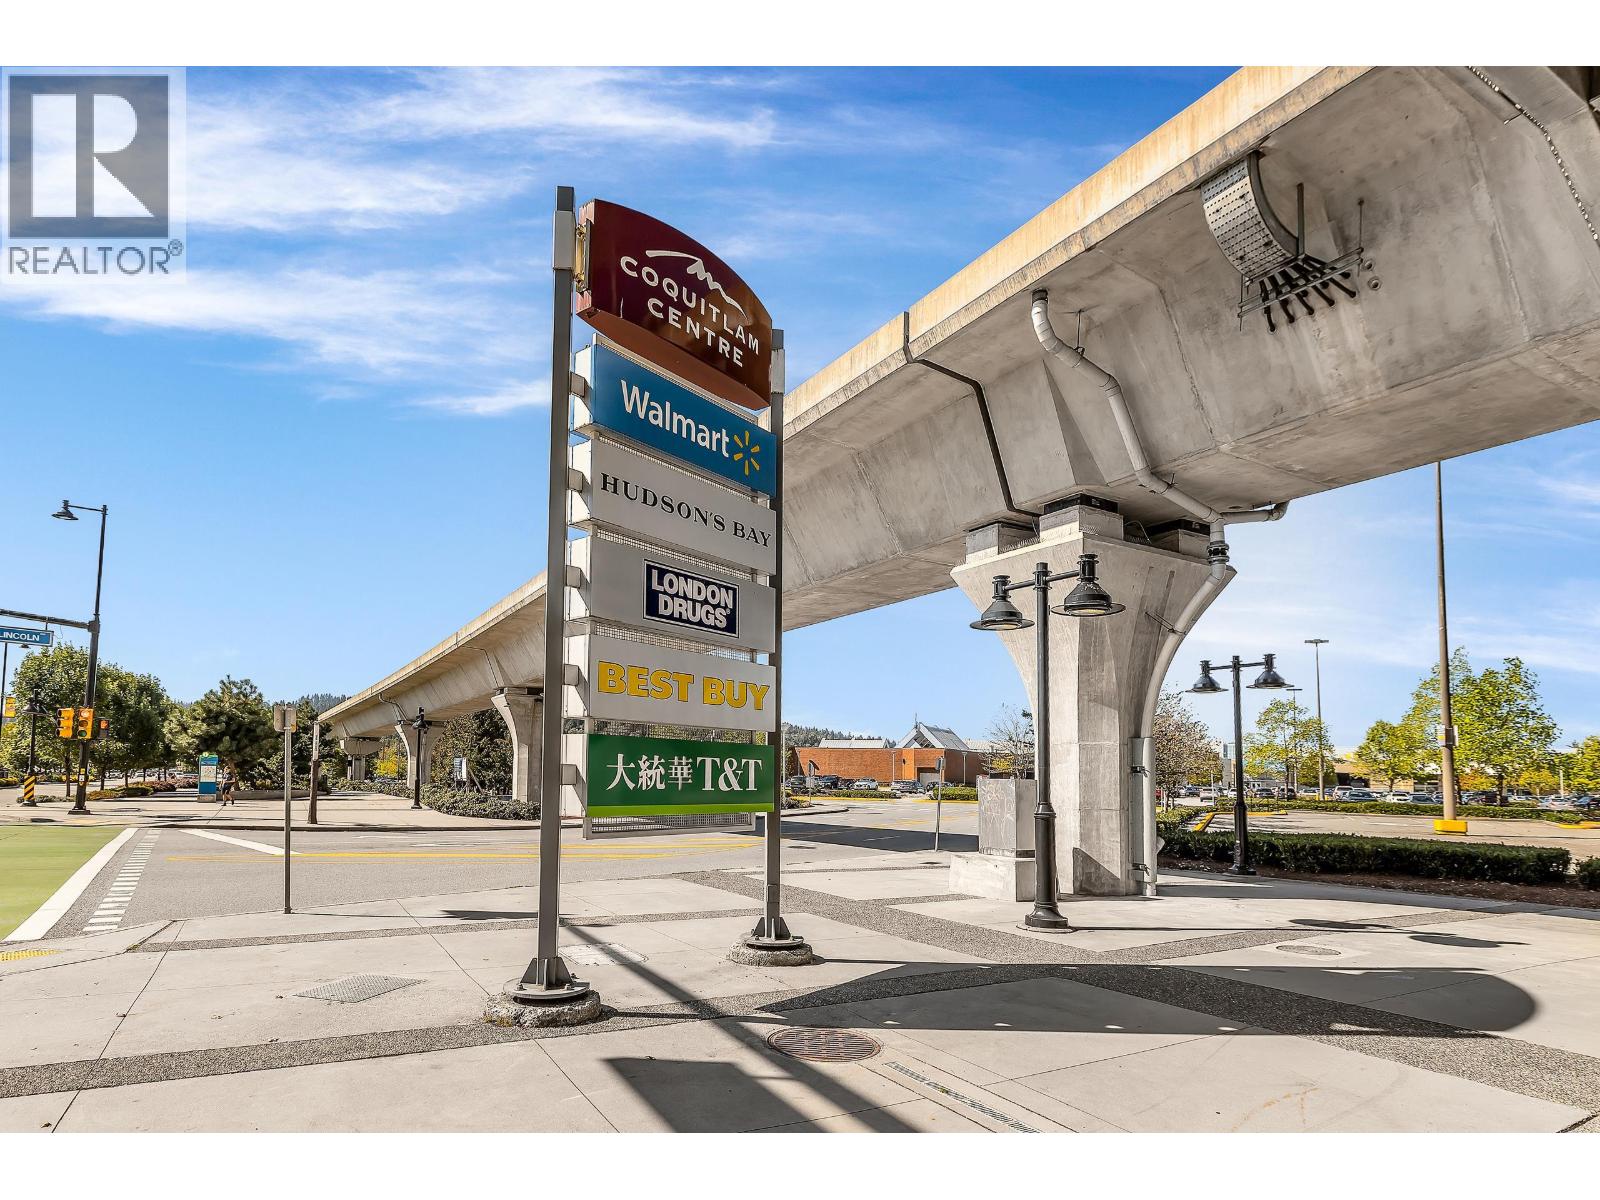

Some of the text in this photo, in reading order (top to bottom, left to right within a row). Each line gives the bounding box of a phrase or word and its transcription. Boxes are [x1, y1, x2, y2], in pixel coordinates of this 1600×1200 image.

[620, 255, 760, 356] COQUITLAM
[647, 298, 744, 368] CENTRE
[620, 379, 730, 459] Walmart
[600, 472, 771, 548] HUDSON'S BAY
[651, 569, 734, 609] LONDON
[597, 660, 770, 710] BEST BUY
[605, 753, 763, 792] 大統華 T&T
